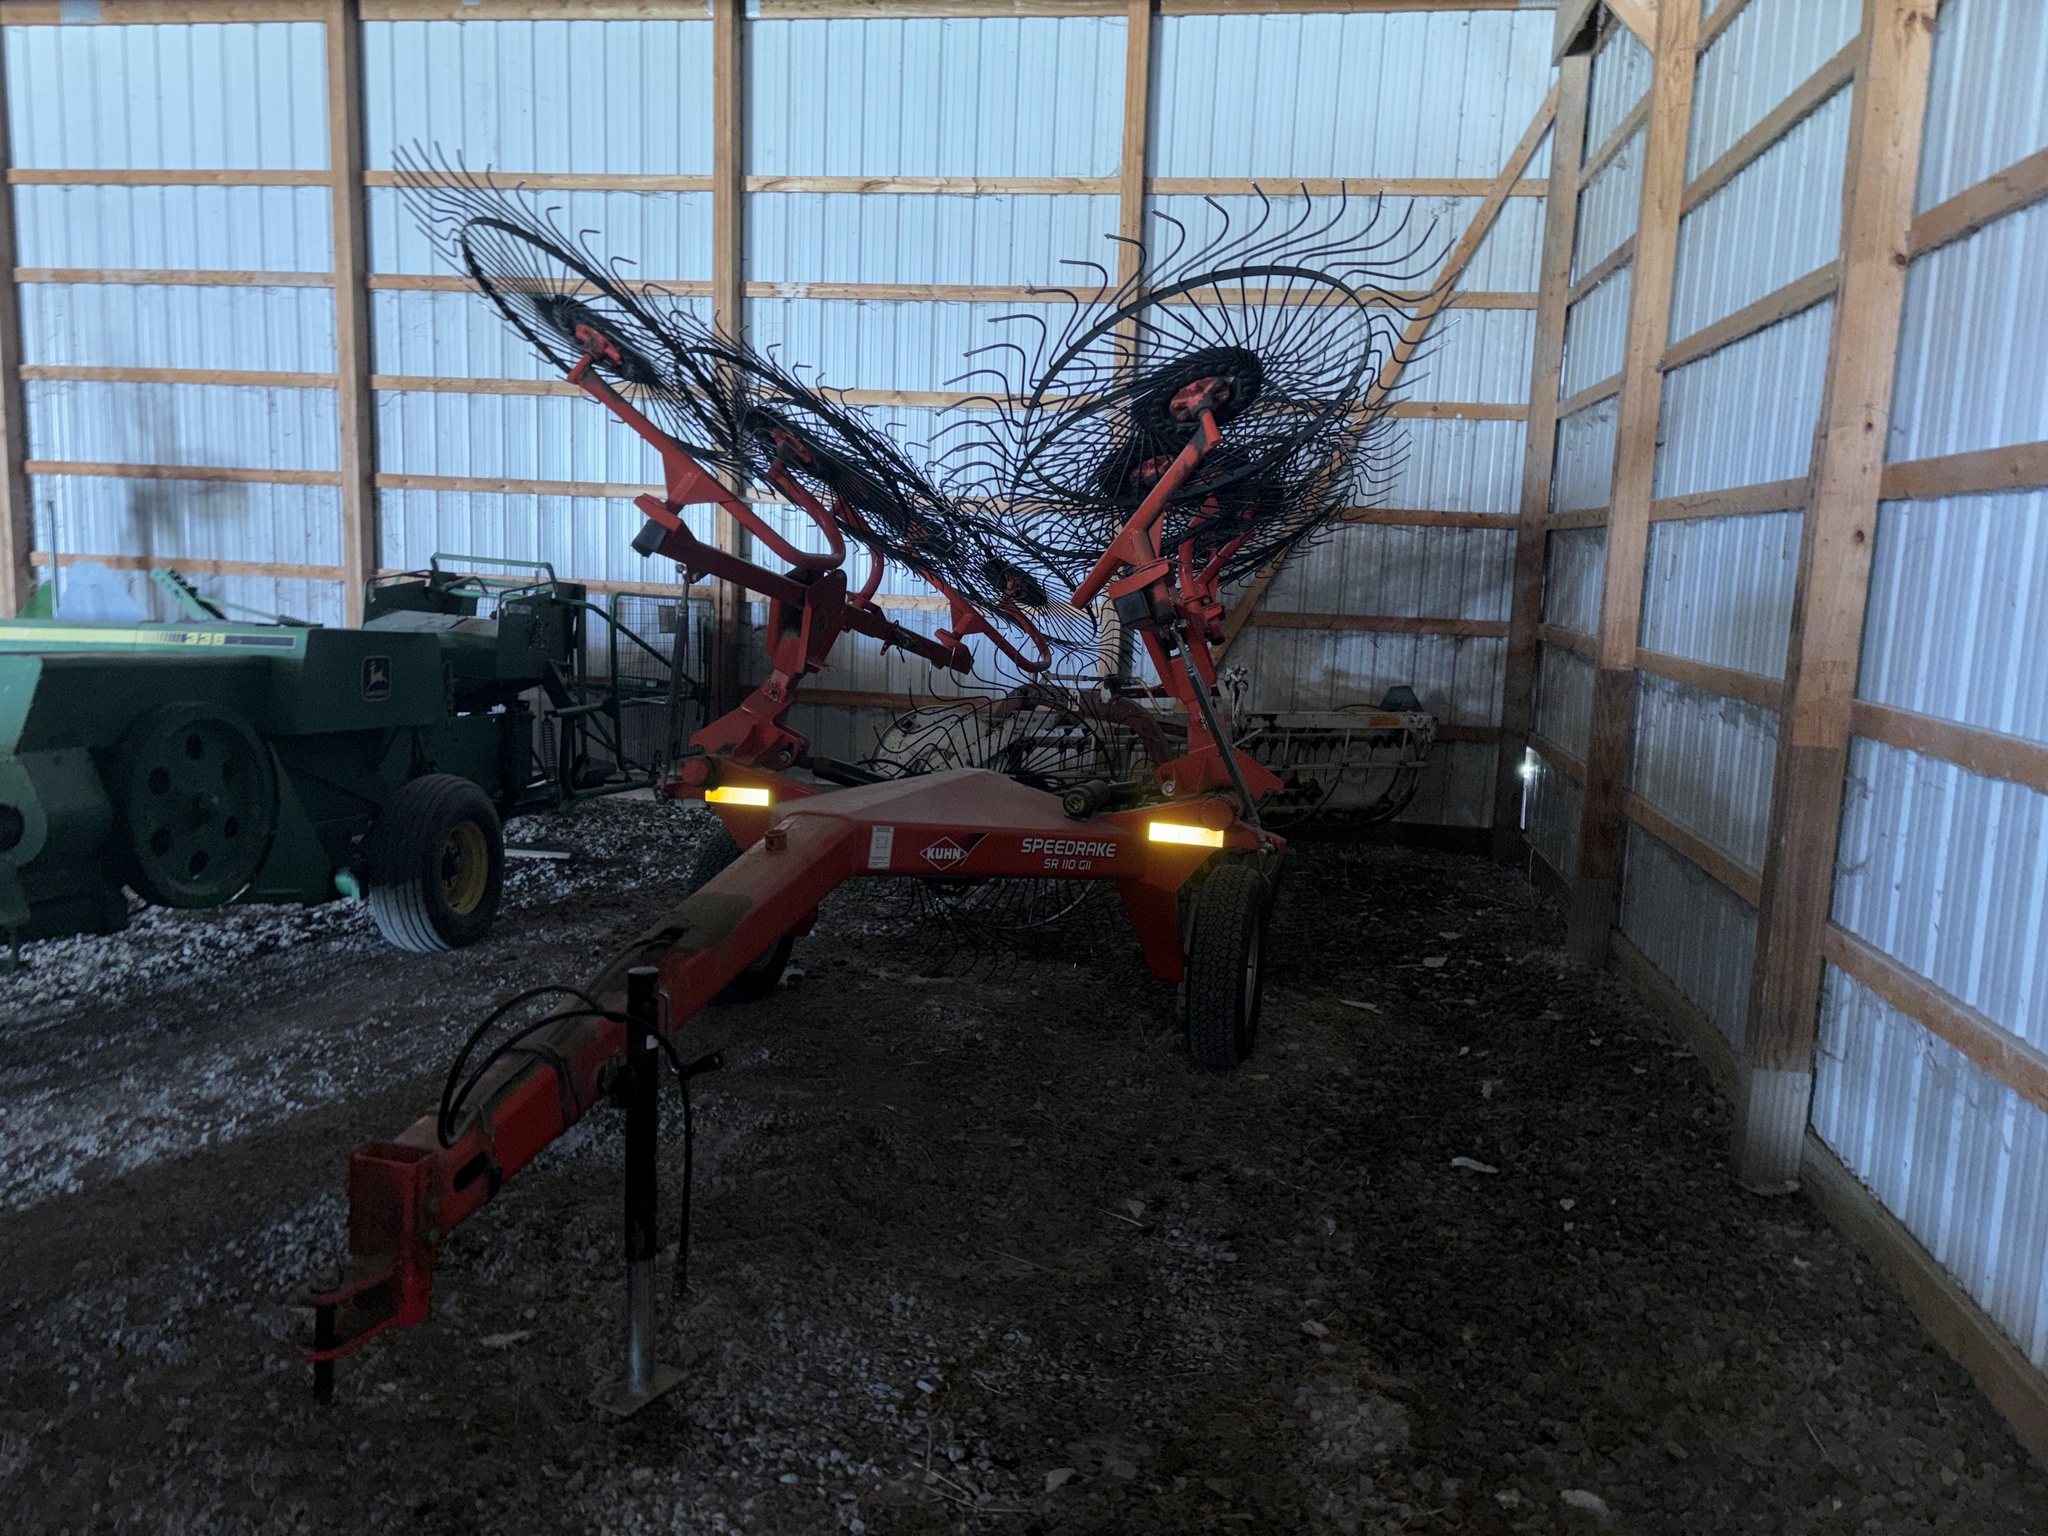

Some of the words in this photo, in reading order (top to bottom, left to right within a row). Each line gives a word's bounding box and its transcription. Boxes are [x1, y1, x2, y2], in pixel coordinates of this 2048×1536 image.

[926, 847, 960, 860] KUHN
[1021, 838, 1117, 858] SPEEDRAKE
[1043, 858, 1059, 869] SR
[1061, 859, 1077, 870] 110
